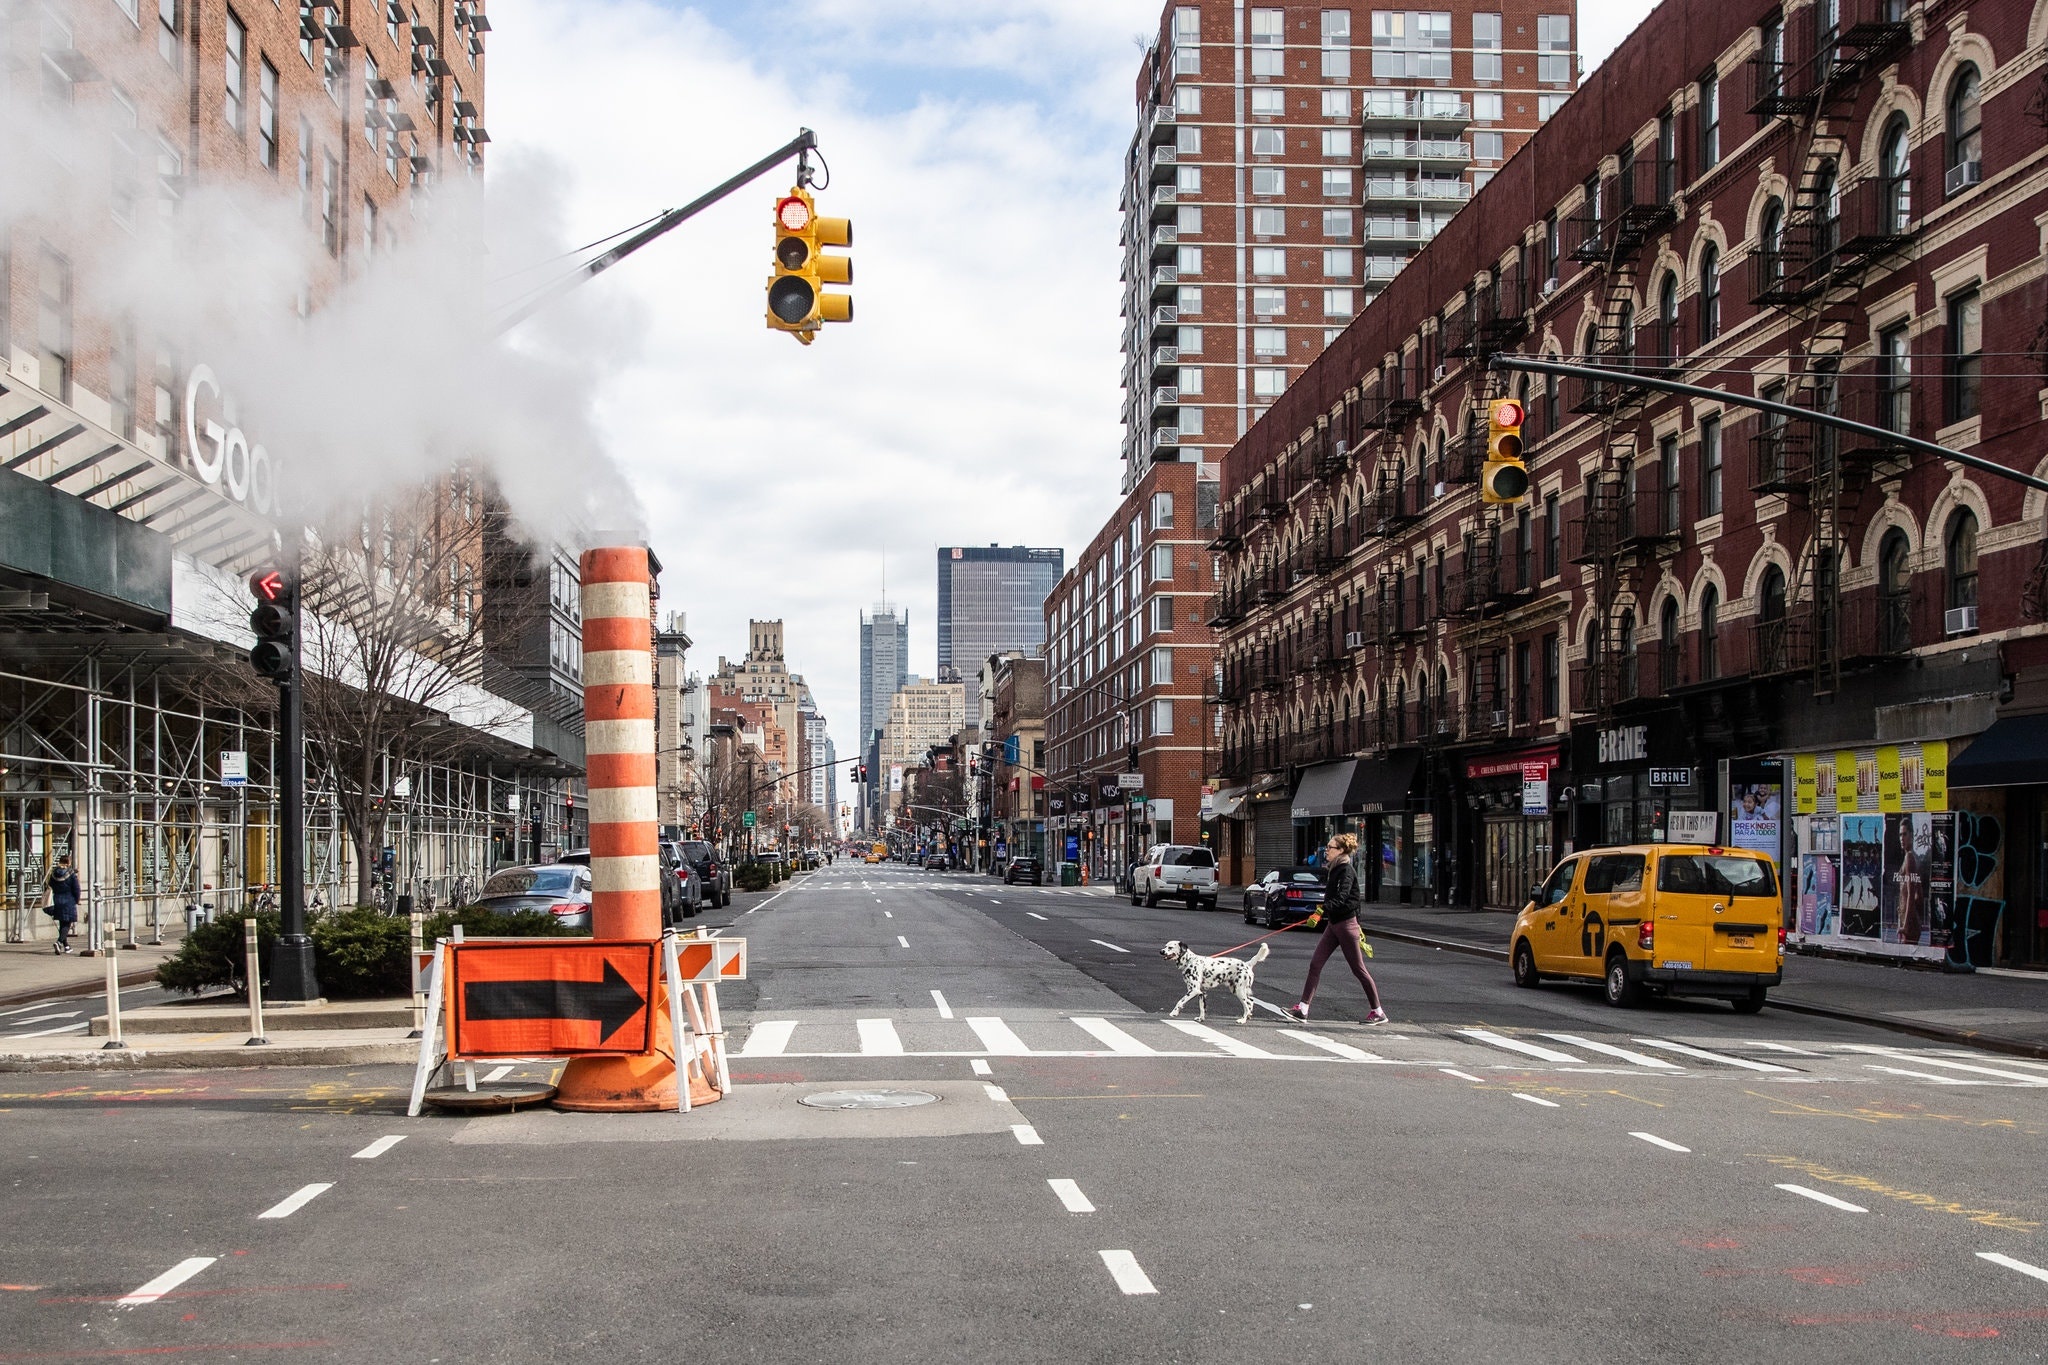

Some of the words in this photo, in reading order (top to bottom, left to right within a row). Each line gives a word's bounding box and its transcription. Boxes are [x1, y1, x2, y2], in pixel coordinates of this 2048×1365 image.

[1880, 771, 1899, 780] Kosas
[1926, 768, 1945, 777] Kosas
[1798, 777, 1815, 785] Kosas
[1837, 775, 1855, 783] Kosas
[1102, 785, 1120, 797] NYSC
[1546, 921, 1556, 931] NYC
